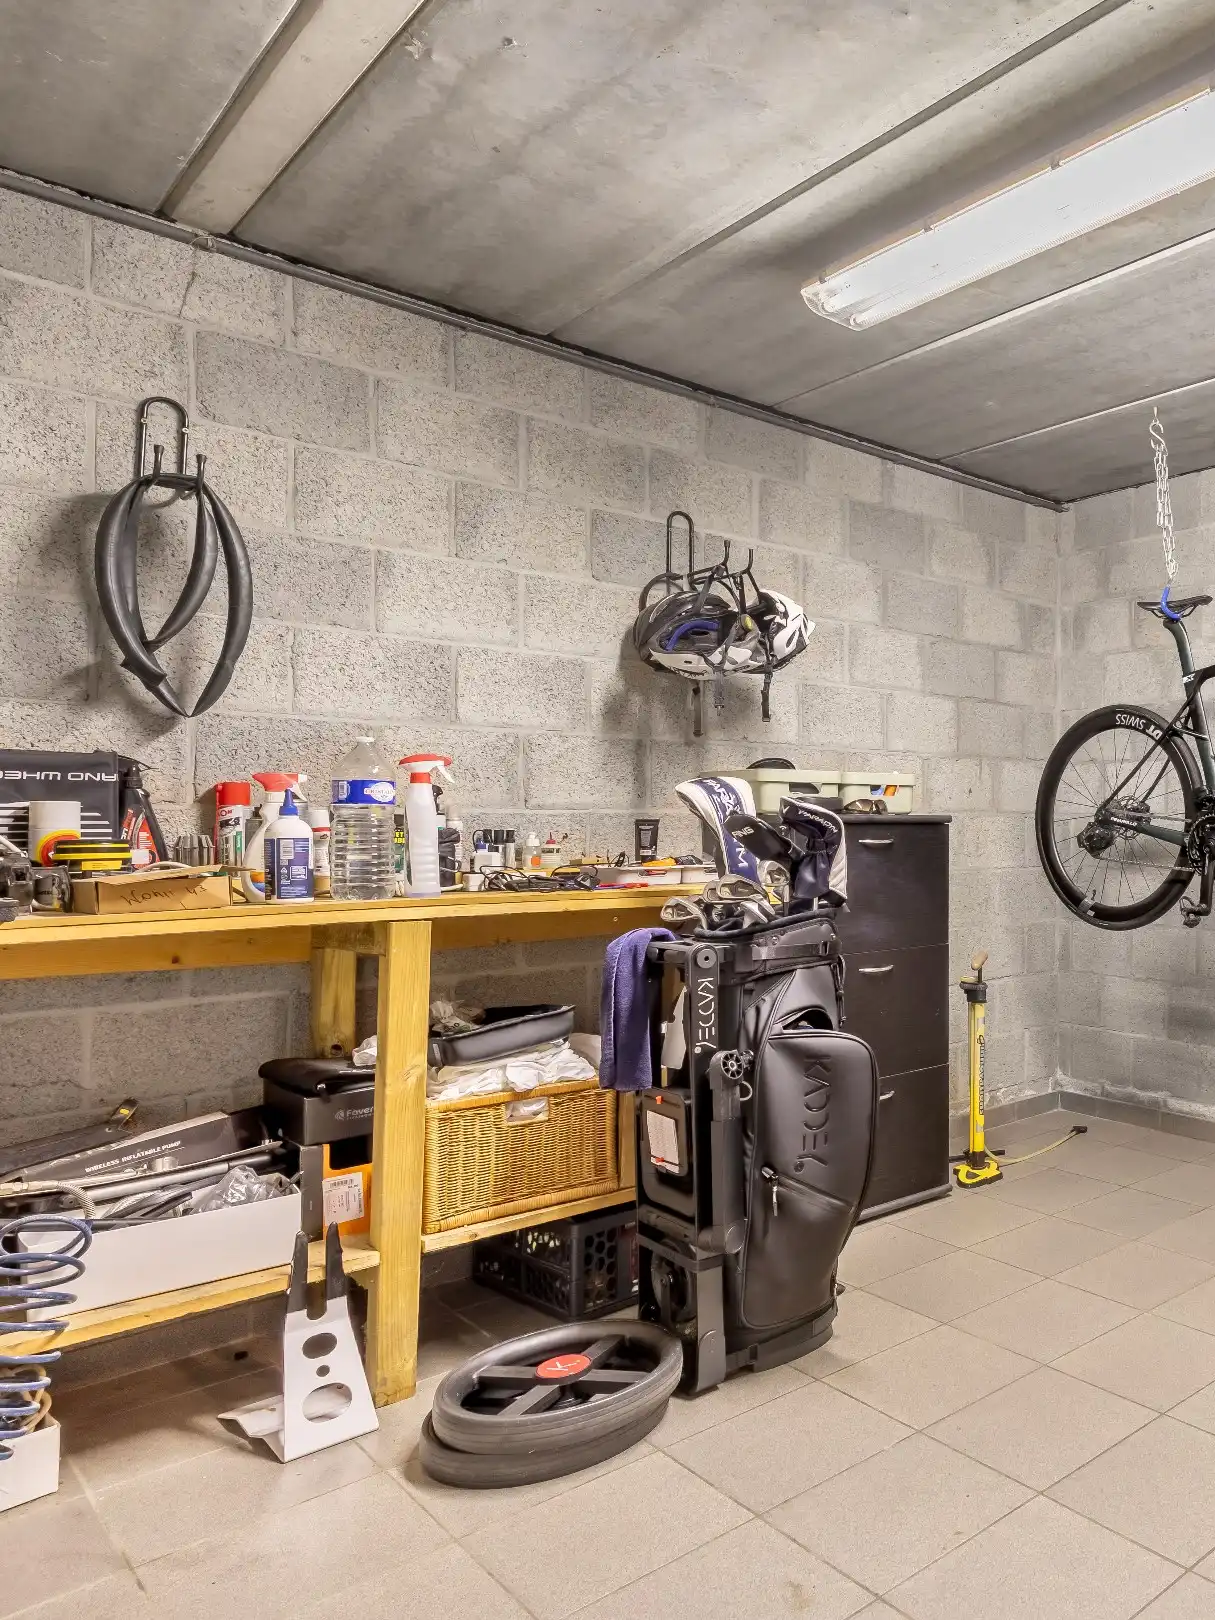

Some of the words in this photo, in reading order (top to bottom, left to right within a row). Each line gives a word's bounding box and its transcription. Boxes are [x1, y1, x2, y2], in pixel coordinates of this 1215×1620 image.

[1115, 713, 1147, 730] SWISS
[1146, 724, 1164, 742] DT
[66, 771, 119, 782] ANO
[346, 1106, 375, 1117] Faver
[84, 1158, 120, 1173] WIRELESS
[121, 1146, 162, 1162] INFLATABLE
